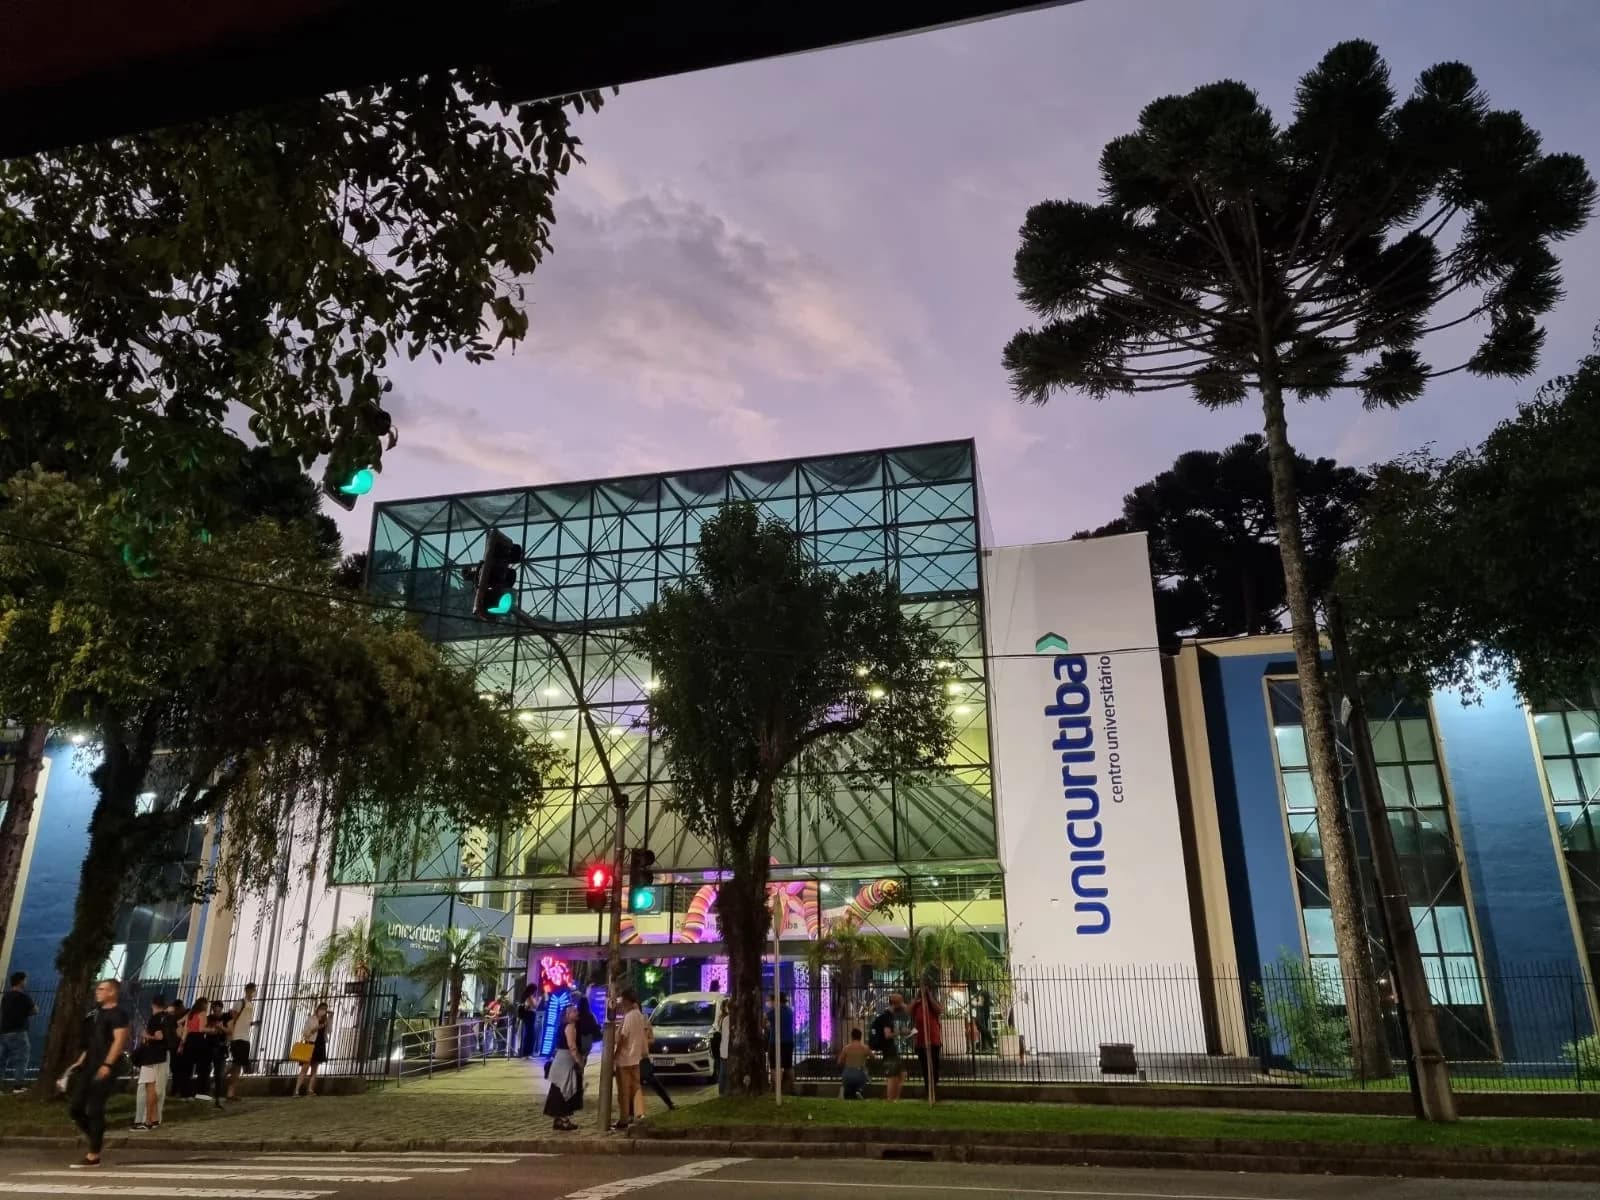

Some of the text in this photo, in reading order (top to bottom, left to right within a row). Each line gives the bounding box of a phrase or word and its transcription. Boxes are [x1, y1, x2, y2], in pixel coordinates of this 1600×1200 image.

[1045, 655, 1111, 934] unicuritiba
[1099, 655, 1124, 804] centro universitário
